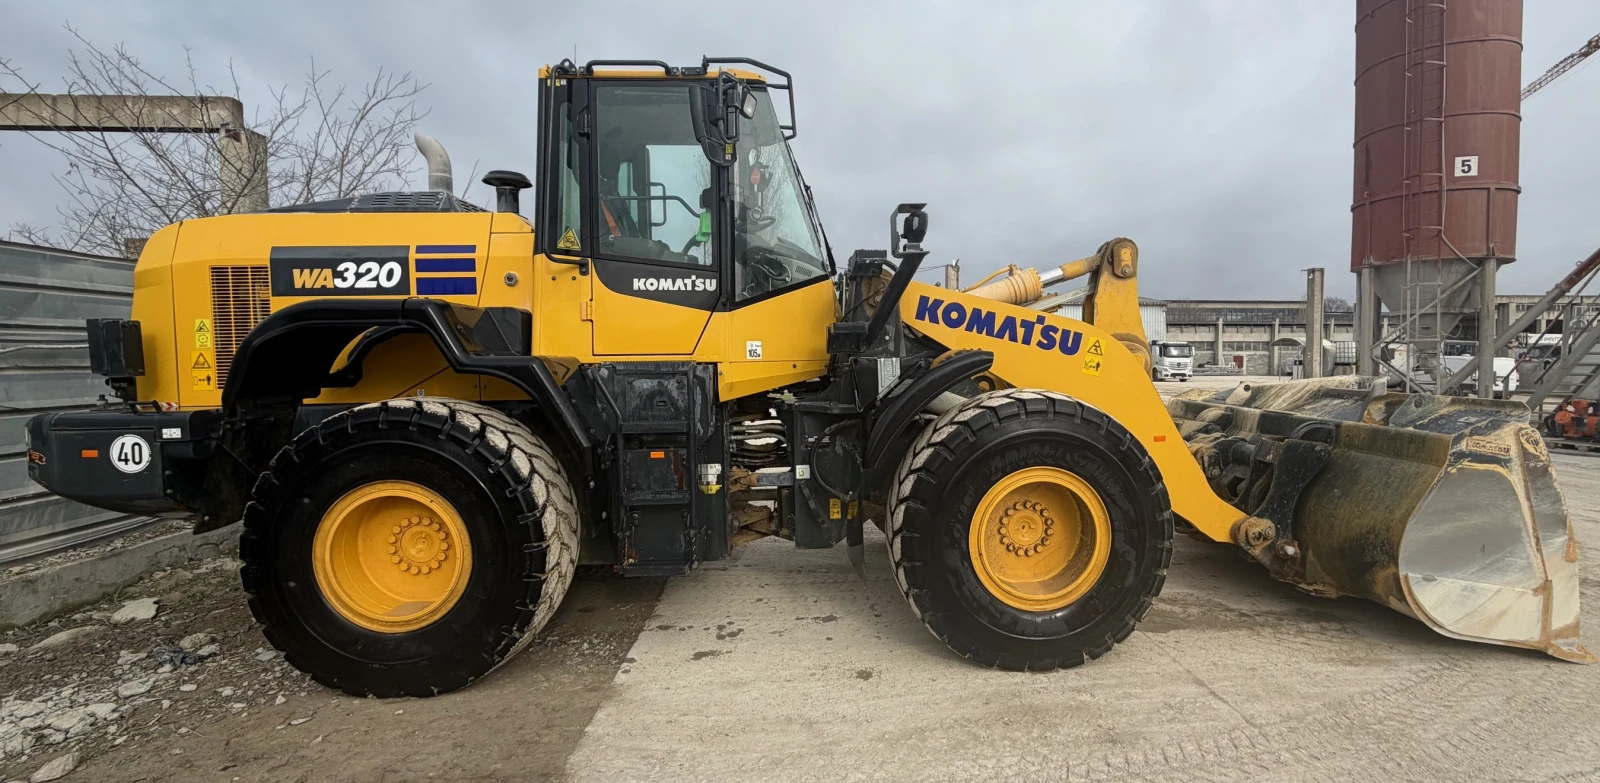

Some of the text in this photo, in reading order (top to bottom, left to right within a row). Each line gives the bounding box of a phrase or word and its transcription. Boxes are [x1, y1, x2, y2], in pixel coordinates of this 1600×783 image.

[1461, 159, 1472, 174] 5
[292, 261, 402, 289] WA320
[633, 274, 717, 292] KOMATSU
[915, 295, 1083, 356] KOMATSU
[117, 442, 143, 465] 40
